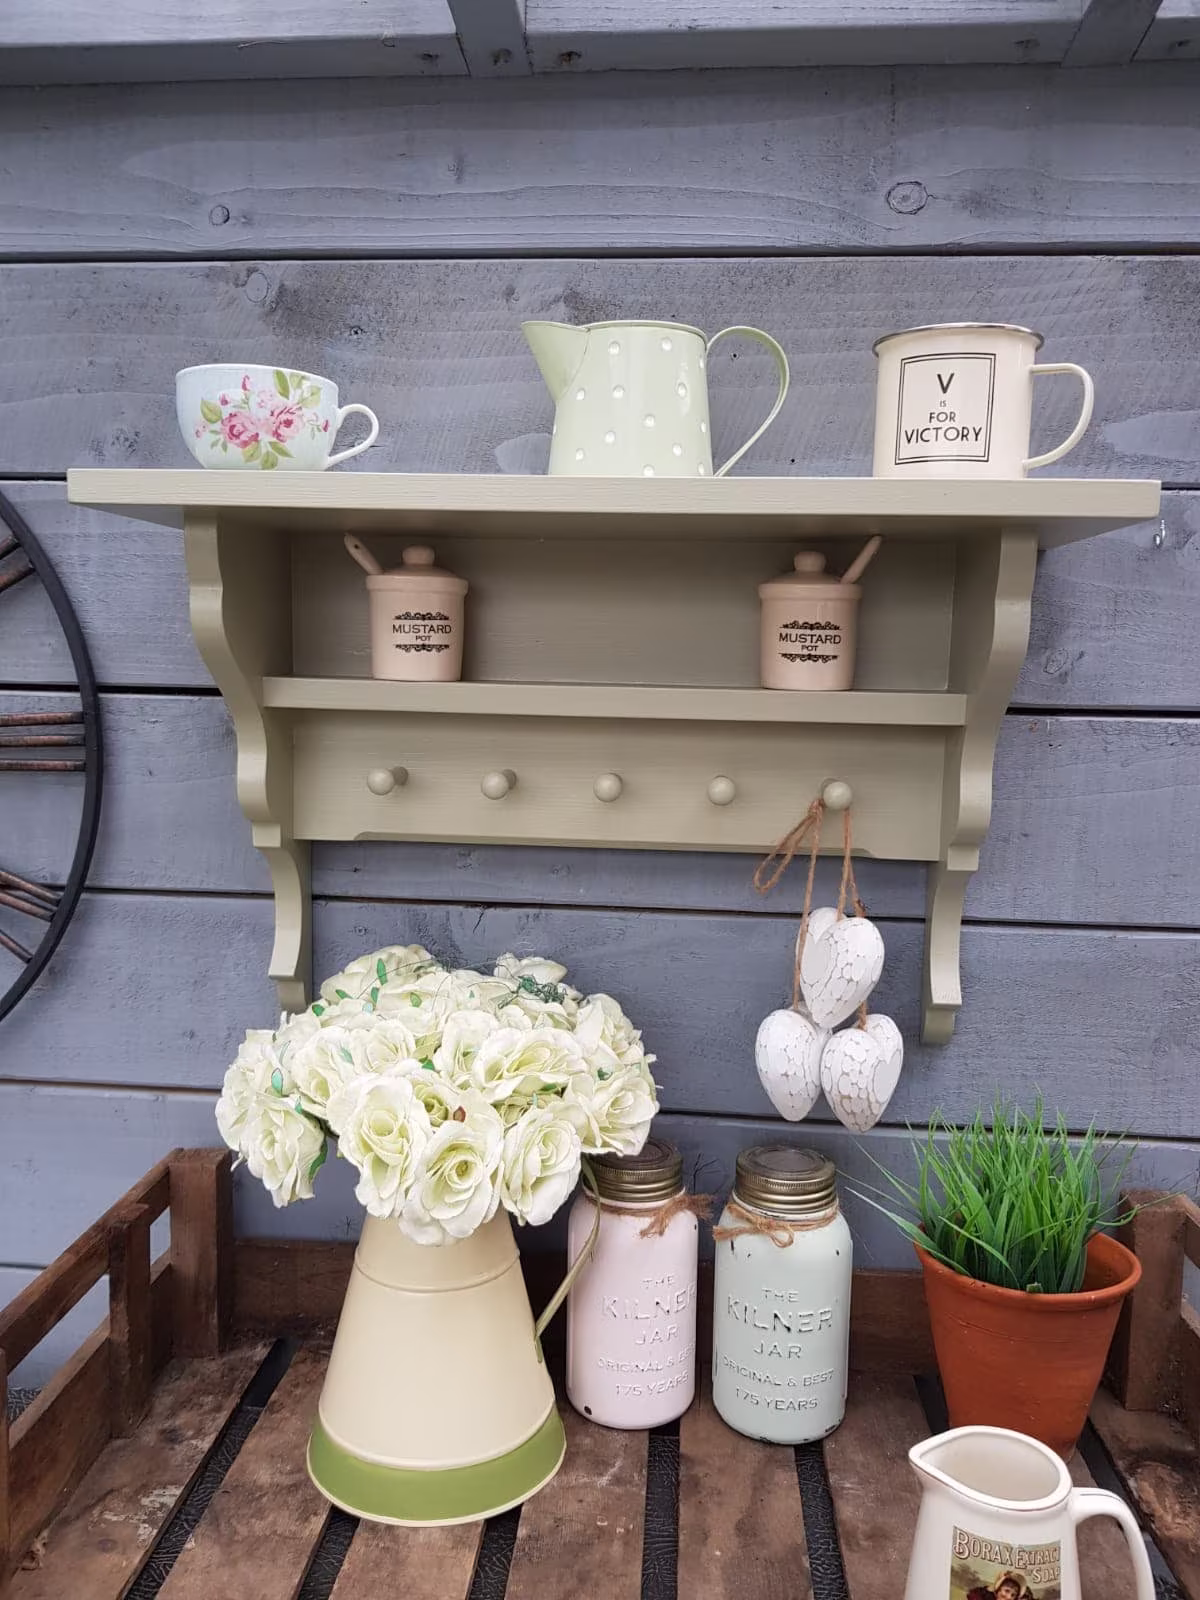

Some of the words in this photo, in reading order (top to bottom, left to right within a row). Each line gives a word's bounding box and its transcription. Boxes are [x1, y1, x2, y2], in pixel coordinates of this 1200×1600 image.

[937, 372, 955, 394] V
[939, 400, 947, 408] IS
[928, 411, 956, 424] FOR
[904, 426, 983, 445] VICTORY
[392, 623, 452, 635] MUSTARD
[778, 632, 842, 645] MUSTARD
[801, 644, 819, 652] POT
[761, 1287, 800, 1303] THE
[728, 1295, 832, 1332] KILNER
[634, 1324, 680, 1346] JAR
[753, 1340, 803, 1359] JAR
[721, 1355, 782, 1386] ORIGINAL
[787, 1375, 798, 1388] &
[802, 1367, 836, 1388] BEST
[616, 1383, 643, 1398] 175
[646, 1369, 690, 1397] YEARS
[735, 1385, 761, 1407] 175
[763, 1398, 819, 1412] YEARS
[953, 1529, 1014, 1567] BORAX
